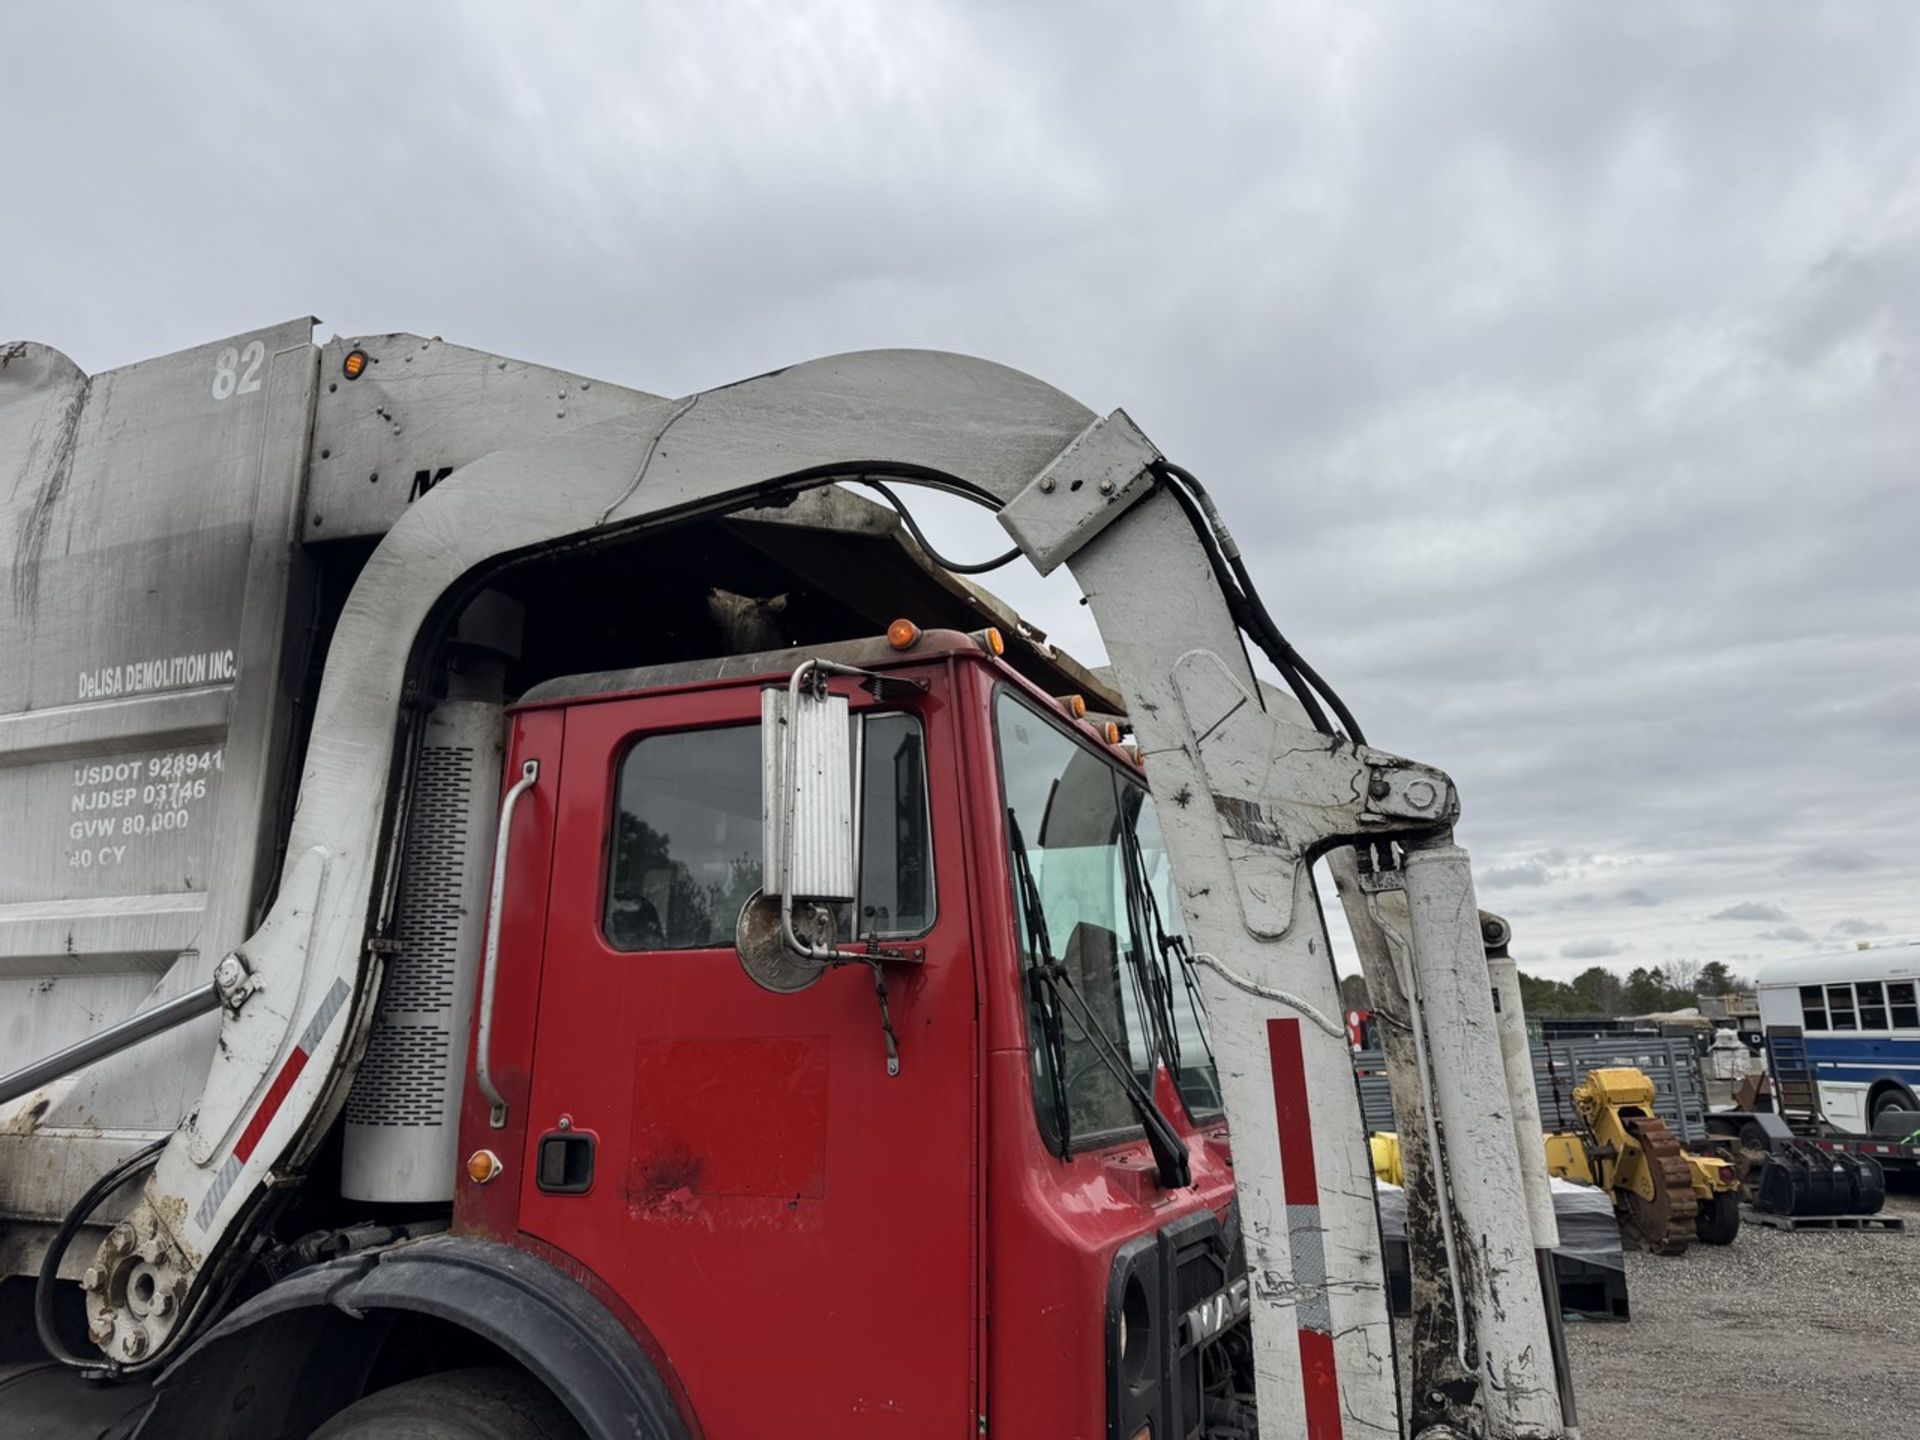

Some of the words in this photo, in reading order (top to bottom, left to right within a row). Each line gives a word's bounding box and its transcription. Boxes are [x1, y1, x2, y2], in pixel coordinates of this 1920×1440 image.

[212, 340, 265, 400] 82
[79, 666, 122, 698] DeLISA
[126, 653, 206, 692] DEMOLITION
[208, 649, 236, 680] INC.
[74, 760, 142, 787] USDOT
[148, 750, 223, 777] 928941
[72, 788, 137, 813] NJDEP
[70, 817, 115, 840] GVW
[122, 809, 189, 837] 80,000
[69, 849, 91, 868] 40
[99, 845, 126, 865] CY
